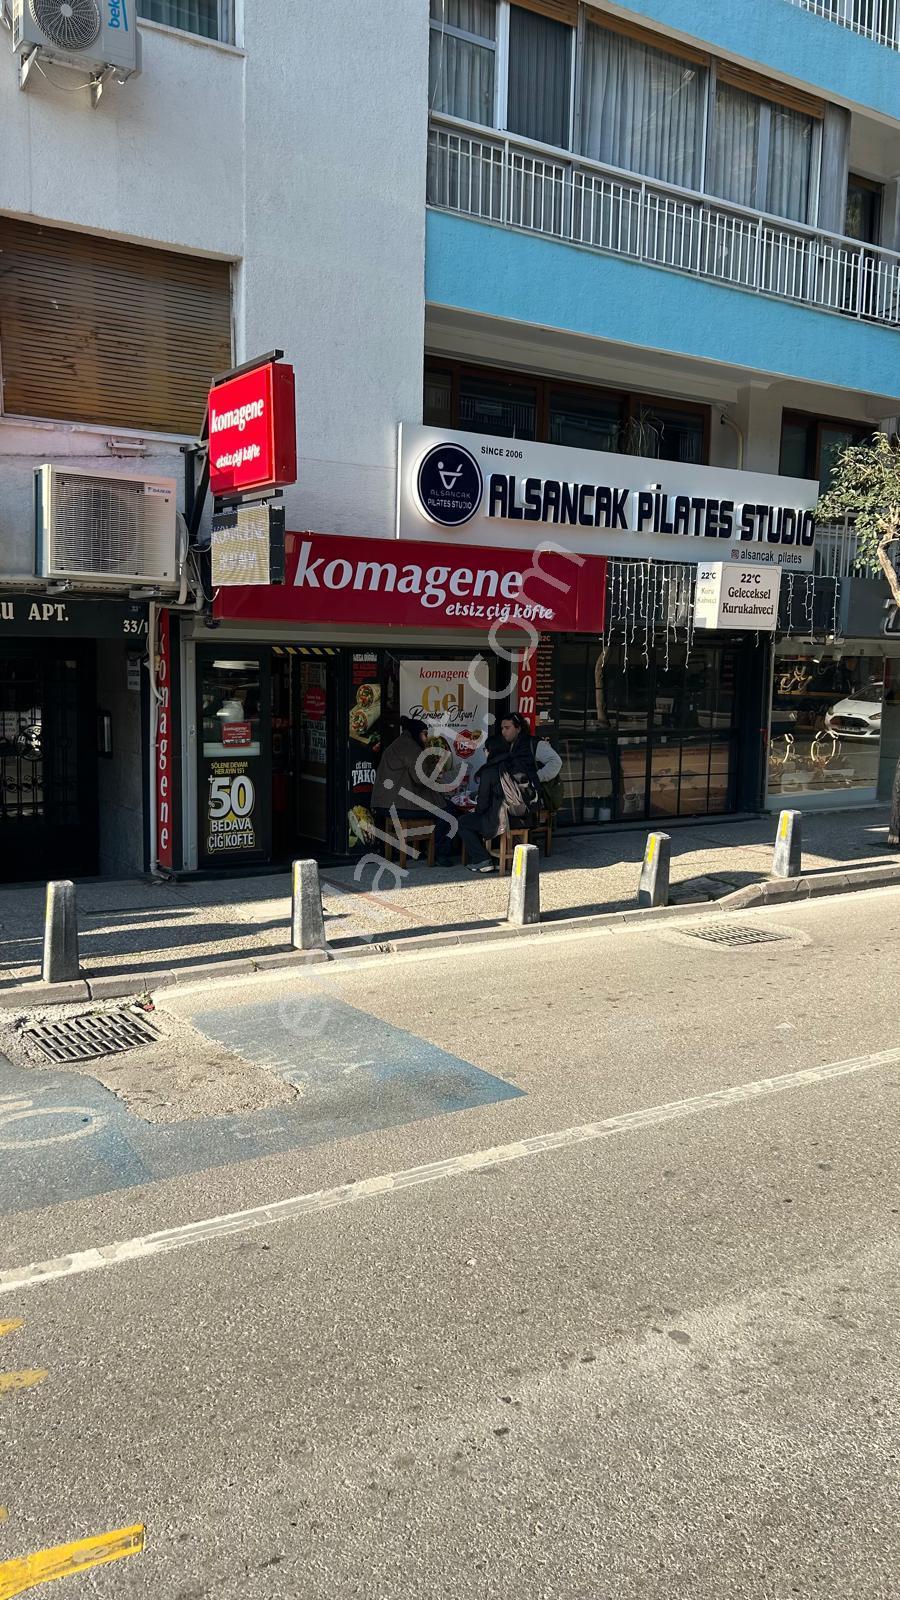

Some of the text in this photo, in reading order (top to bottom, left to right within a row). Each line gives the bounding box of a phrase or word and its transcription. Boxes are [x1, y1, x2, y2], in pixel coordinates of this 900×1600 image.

[211, 399, 264, 433] komagene
[505, 449, 523, 459] 2006
[430, 489, 471, 499] ALSANCAK
[487, 473, 816, 546] ALSANCAK PİLATES STUDIO
[293, 541, 523, 608] komagene
[727, 586, 771, 599] Geleceksel
[28, 602, 69, 621] APT.
[446, 601, 554, 622] etsiz çiğ köfte
[722, 602, 774, 615] Kurukahveci
[419, 667, 470, 682] komagene
[421, 684, 465, 713] Gel
[351, 768, 377, 787] TAKO
[211, 818, 252, 832] BEDAVA
[208, 831, 254, 853] ÇİĞ KÖFTE
